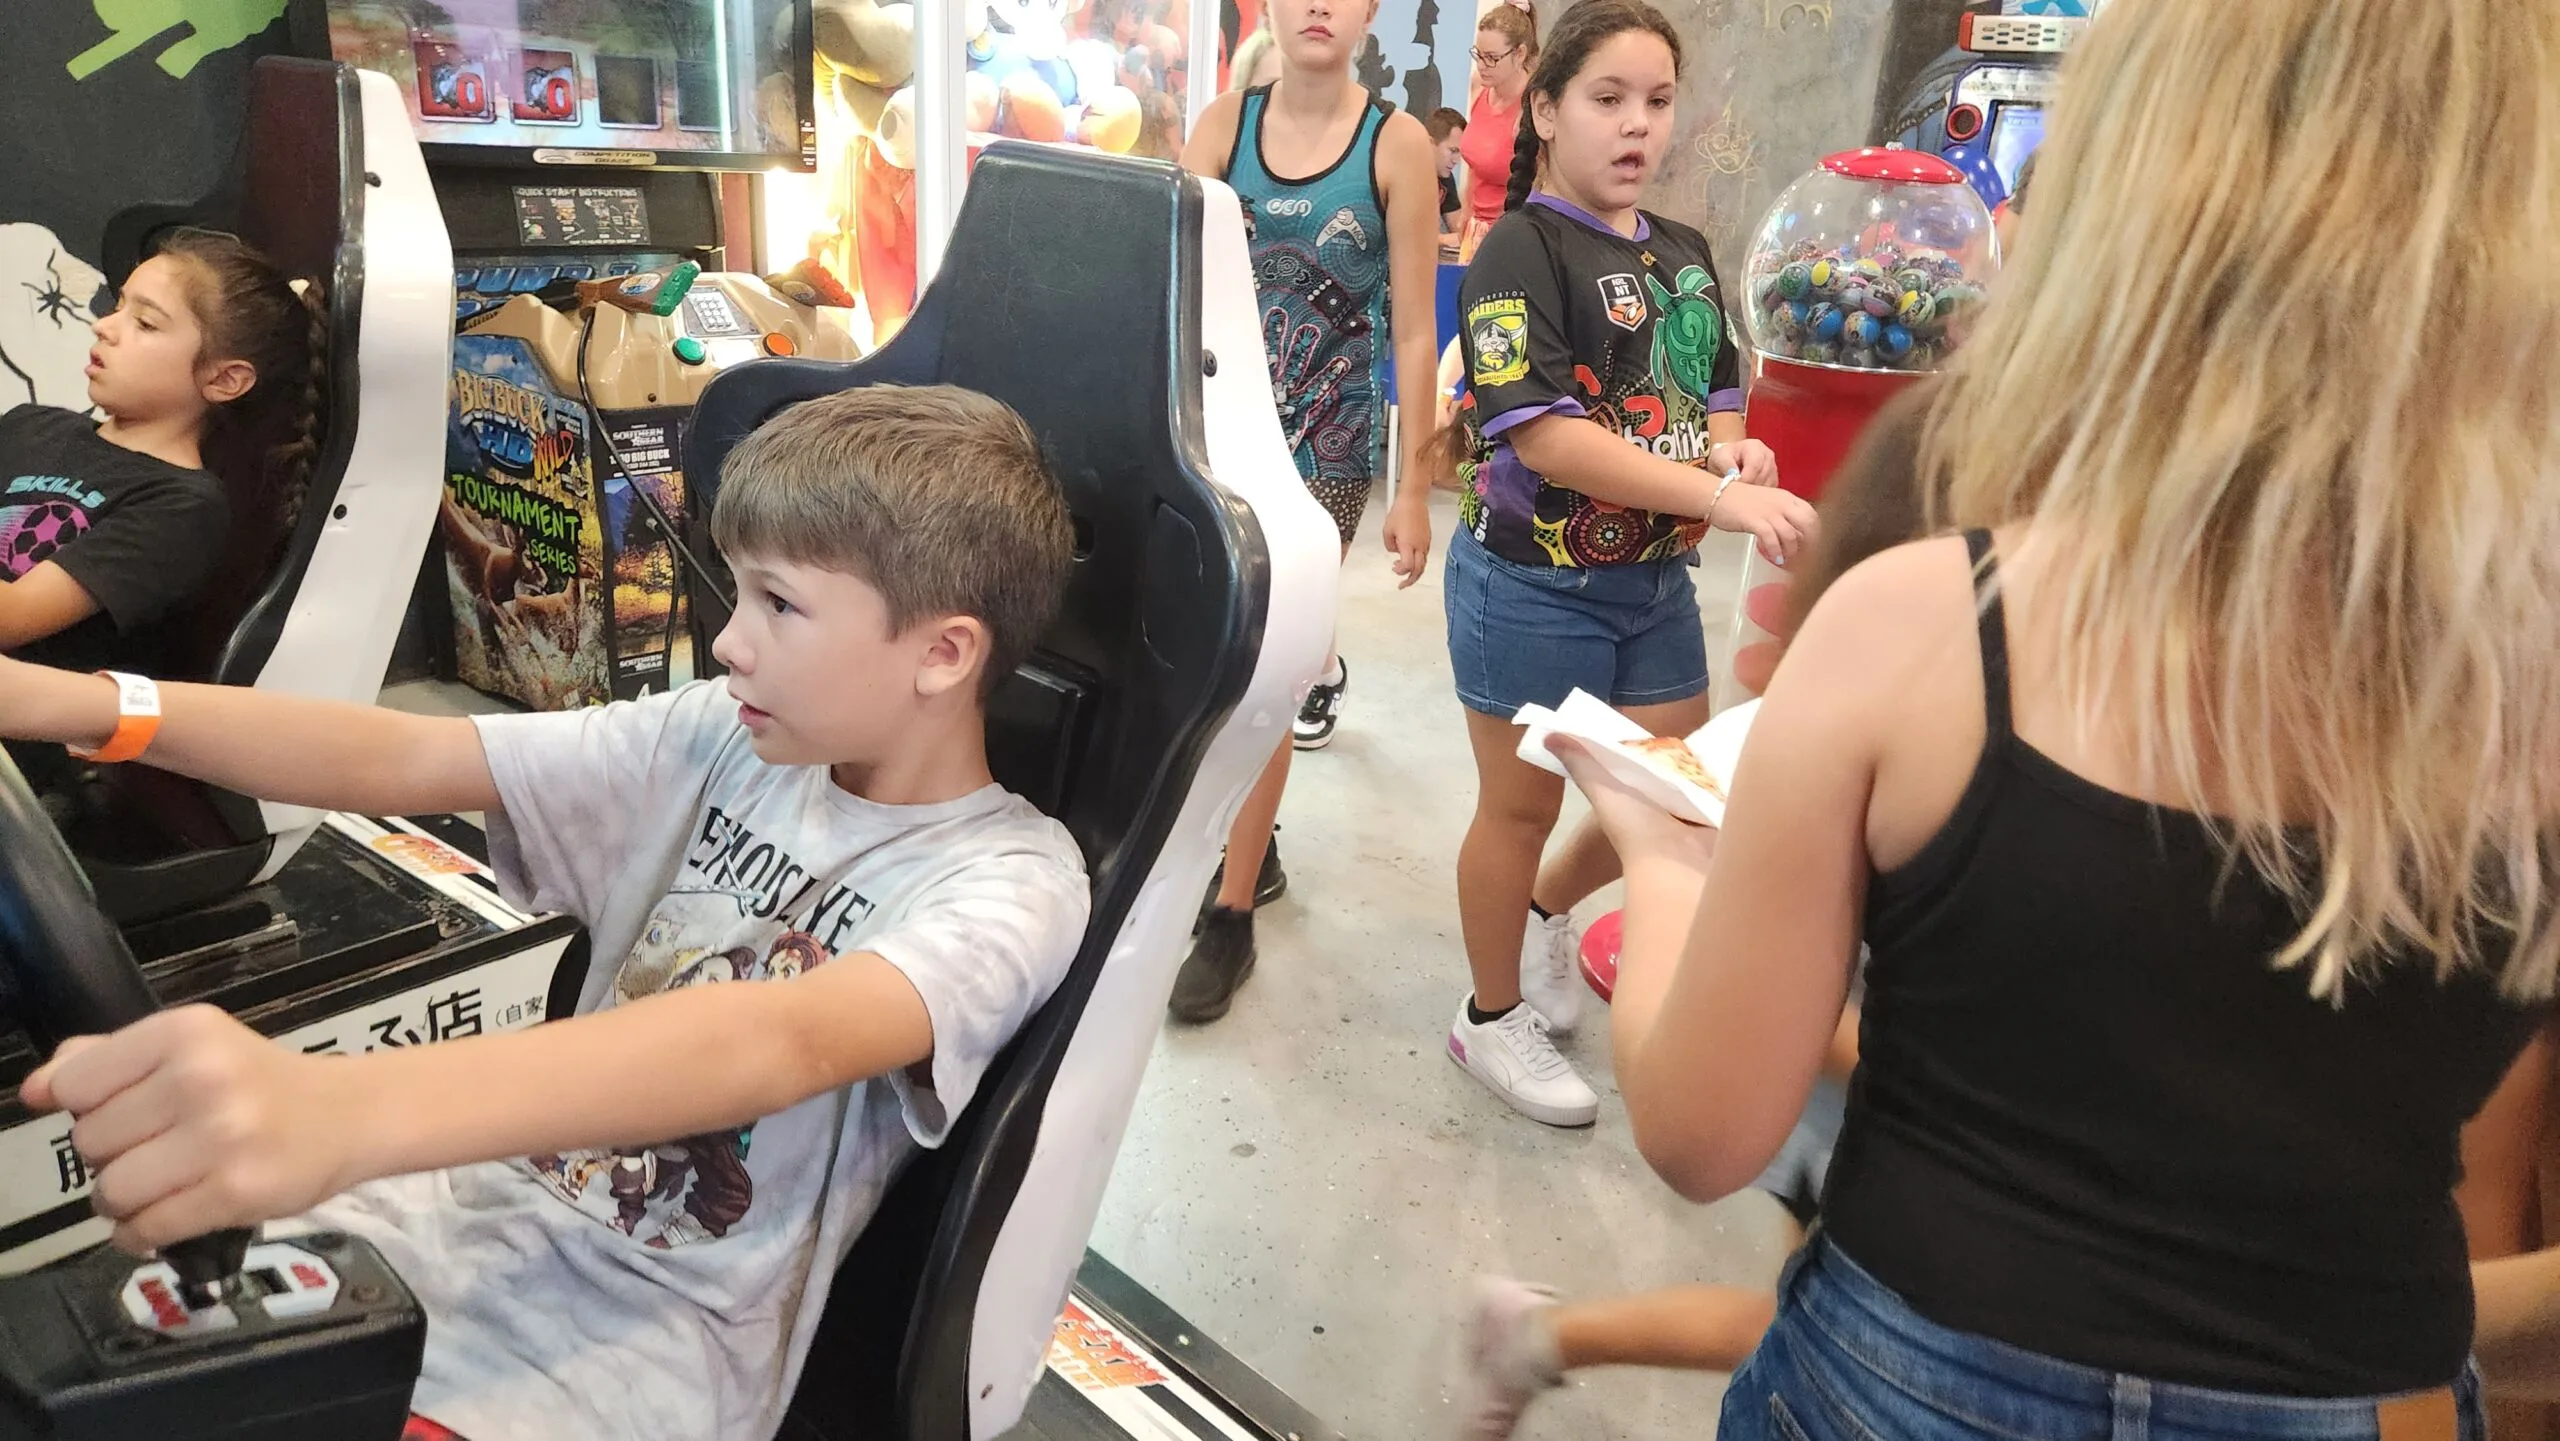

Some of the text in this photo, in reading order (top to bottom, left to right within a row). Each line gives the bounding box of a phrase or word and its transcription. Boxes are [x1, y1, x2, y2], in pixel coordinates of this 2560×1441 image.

[517, 187, 638, 198] QUICK START INSTRUCTIONS
[1614, 284, 1631, 297] NT
[1468, 298, 1526, 324] RAIDERS
[456, 367, 491, 417] BIG
[492, 379, 546, 435] BUCK
[479, 422, 534, 465] HD
[533, 430, 574, 482] WILD
[631, 451, 646, 463] BIG
[646, 448, 671, 462] BUCK
[5, 474, 107, 509] SKILLS
[452, 474, 579, 545] TOURNAMENT
[530, 538, 577, 575] SERIES
